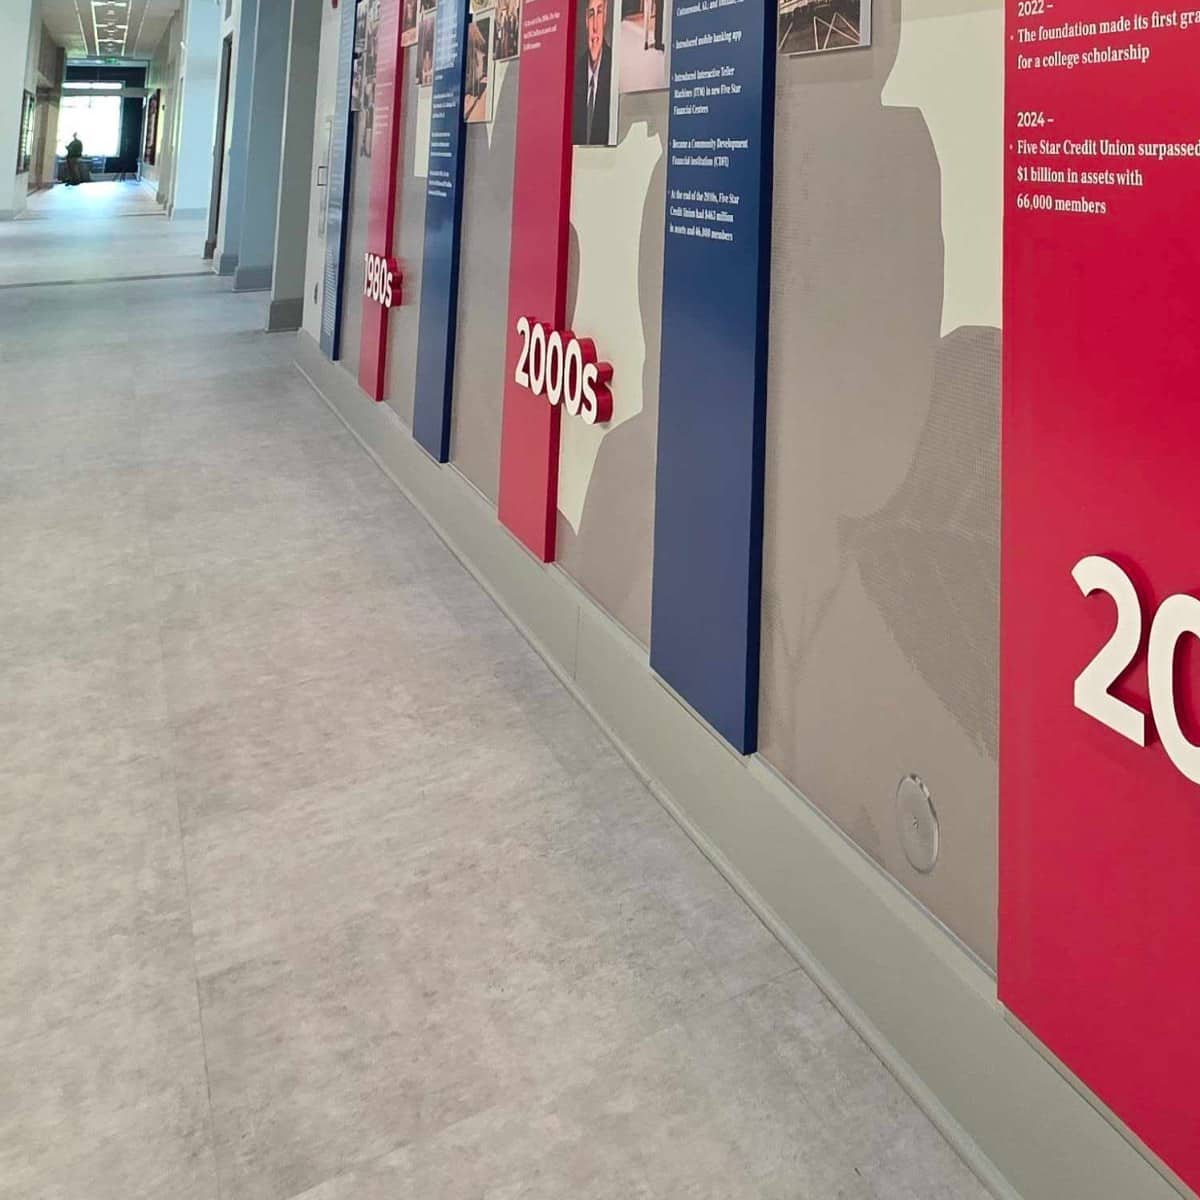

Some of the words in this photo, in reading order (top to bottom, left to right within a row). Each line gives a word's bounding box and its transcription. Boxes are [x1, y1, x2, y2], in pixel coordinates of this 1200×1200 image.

[1017, 27, 1037, 43] The
[1038, 21, 1098, 41] foundation
[1098, 15, 1131, 34] made
[1133, 14, 1149, 31] its
[1151, 10, 1179, 28] first
[1017, 54, 1034, 70] for
[1034, 57, 1041, 68] a
[1042, 51, 1080, 69] college
[1081, 43, 1150, 64] scholarship
[1017, 111, 1046, 128] 2024
[1016, 139, 1038, 155] Five
[1039, 139, 1062, 155] Star
[1062, 139, 1098, 156] Credit
[1099, 139, 1136, 156] Union
[1017, 165, 1029, 182] $1
[1030, 166, 1064, 183] billion
[1067, 169, 1079, 184] in
[1081, 169, 1115, 185] assets
[1117, 169, 1144, 187] with
[1016, 193, 1054, 211] 66,000
[1054, 196, 1107, 215] members
[364, 252, 393, 308] 1980s
[515, 317, 598, 425] 2000s
